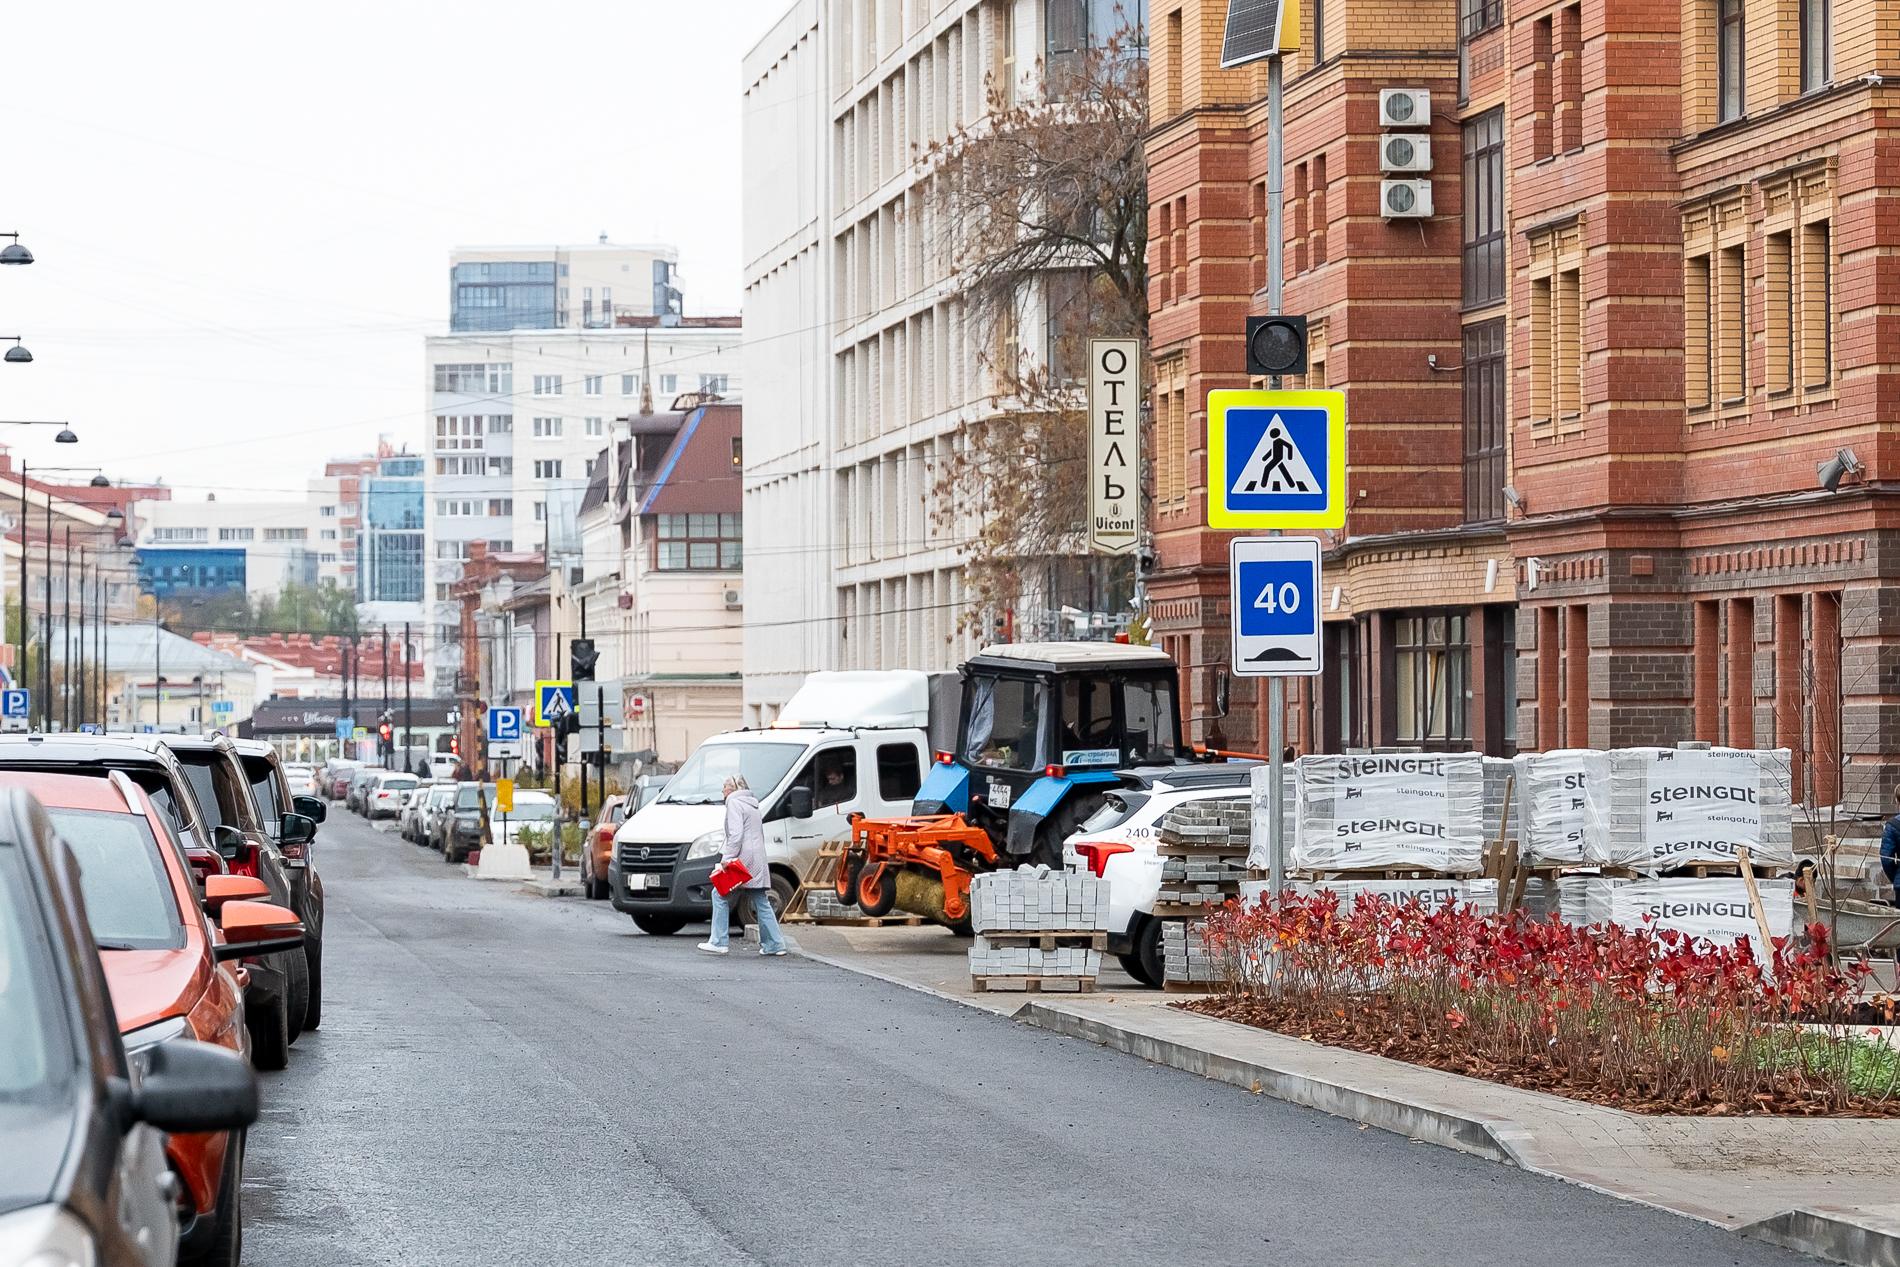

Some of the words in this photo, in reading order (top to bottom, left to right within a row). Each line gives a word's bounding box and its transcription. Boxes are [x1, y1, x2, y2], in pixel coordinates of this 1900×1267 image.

[1101, 348, 1127, 500] ОТЕЛЬ
[1253, 581, 1300, 615] 40
[8, 692, 25, 715] P
[496, 710, 516, 738] P
[1396, 787, 1445, 799] steingot.ru
[1707, 815, 1758, 825] steingot.ru
[1126, 827, 1150, 839] 240
[1396, 843, 1446, 856] steingot.ru
